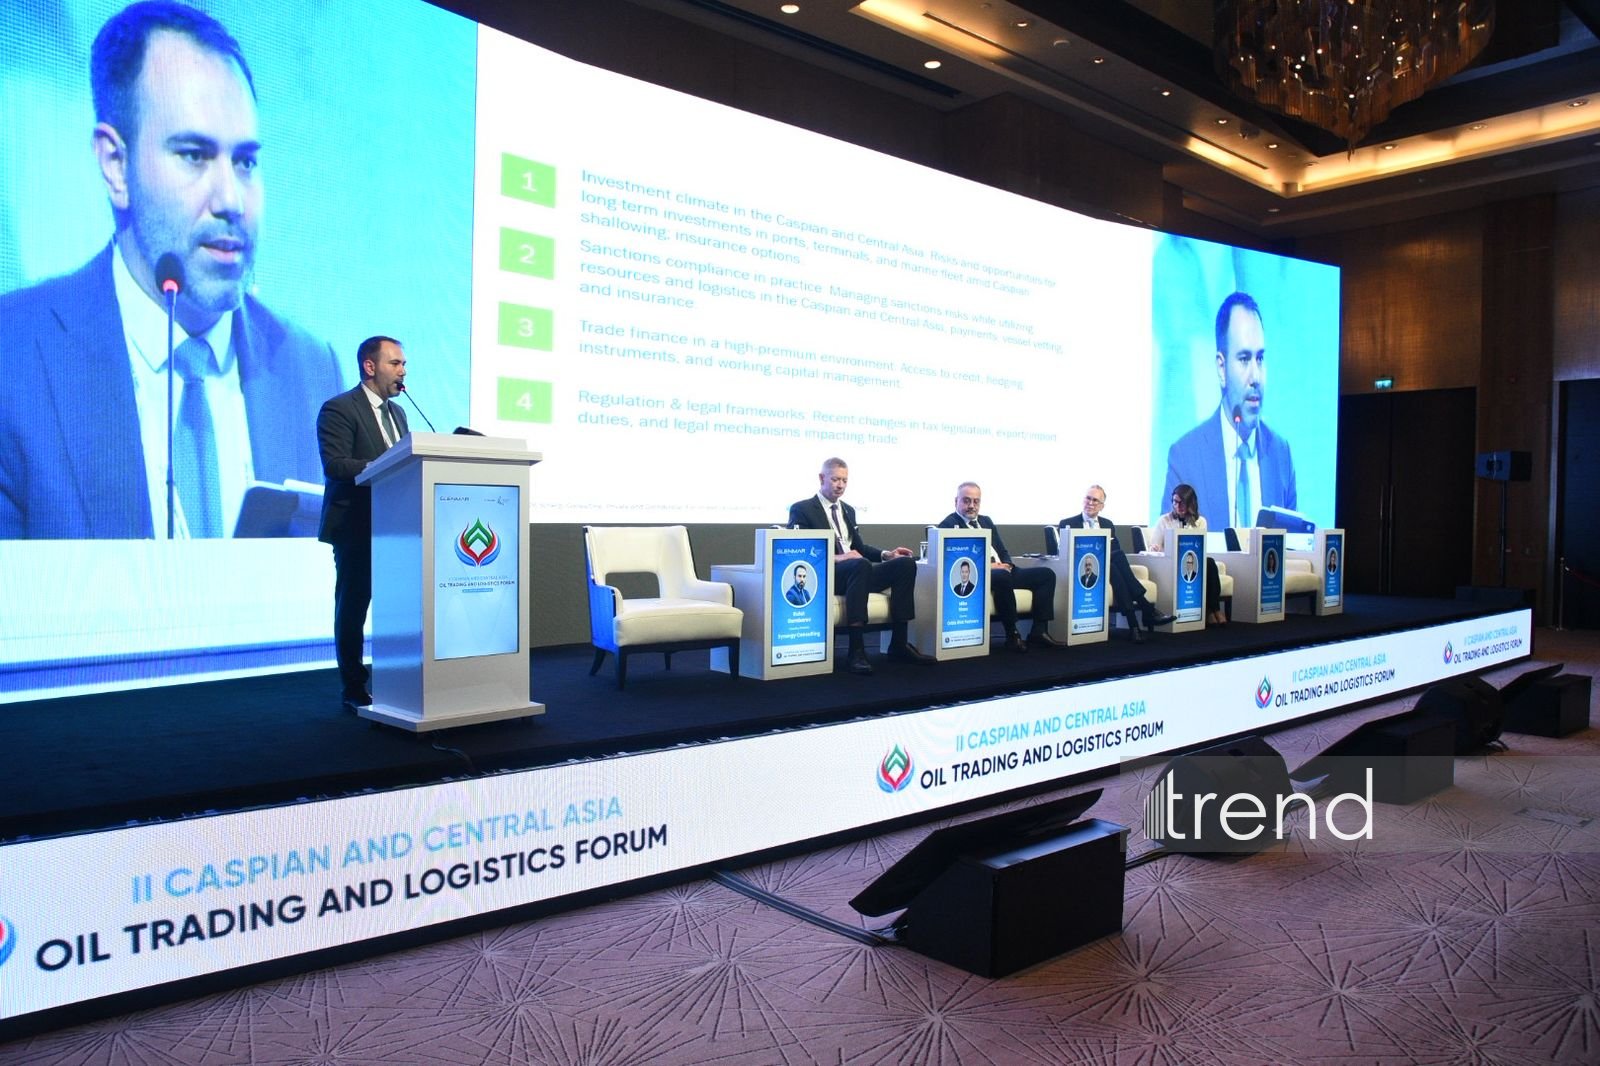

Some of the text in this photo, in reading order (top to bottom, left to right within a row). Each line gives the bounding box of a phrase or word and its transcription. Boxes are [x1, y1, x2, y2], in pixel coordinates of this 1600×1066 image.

[522, 171, 537, 192] 1
[582, 170, 671, 200] Investment
[676, 192, 728, 212] climate
[734, 203, 746, 216] in
[751, 207, 772, 223] the
[776, 213, 828, 235] Caspian
[832, 228, 854, 241] and
[858, 231, 900, 251] Central
[930, 248, 958, 265] Risks
[960, 258, 980, 270] and
[582, 190, 617, 212] long
[622, 198, 658, 217] term
[664, 207, 751, 236] investments
[756, 226, 768, 240] in
[876, 256, 898, 268] and
[901, 261, 938, 277] marine
[940, 268, 964, 281] fleet
[519, 244, 535, 264] 2
[676, 229, 747, 254] insurance
[580, 240, 661, 265] Sanctions
[666, 258, 750, 281] compliance
[754, 271, 766, 284] in
[830, 285, 888, 307] Managing
[891, 299, 942, 317] sanctions
[945, 308, 968, 321] risks
[972, 314, 996, 326] while
[580, 282, 611, 296] and
[580, 264, 660, 285] resources
[665, 278, 693, 290] and
[699, 280, 756, 300] logistics
[761, 290, 772, 303] in
[776, 293, 798, 308] the
[801, 298, 850, 316] Caspian
[854, 309, 876, 320] and
[880, 311, 919, 328] Central
[517, 318, 534, 337] 3
[579, 320, 624, 337] Trade
[630, 326, 688, 345] finance
[692, 335, 706, 347] in
[710, 340, 720, 349] a
[724, 339, 816, 360] high-premium
[901, 362, 937, 376] Access
[684, 356, 712, 367] and
[718, 360, 772, 377] working
[776, 367, 818, 379] capital
[516, 392, 533, 412] 4
[578, 390, 664, 409] Regulation
[670, 398, 682, 410] &
[687, 400, 721, 415] legal
[812, 411, 855, 424] Recent
[858, 416, 906, 430] changes
[910, 420, 920, 430] in
[922, 421, 938, 431] tax
[578, 412, 632, 428] duties,
[639, 417, 668, 429] and
[674, 418, 709, 434] legal
[714, 424, 800, 438] mechanisms
[805, 429, 864, 445] impacting
[1298, 666, 1328, 682] CASPIAN
[1330, 662, 1344, 674] AND
[1345, 656, 1372, 672] CENTRAL
[1373, 652, 1386, 665] ASIA
[1275, 668, 1396, 708] OIL TRADING AND LOGISTICS FORUM
[956, 700, 1146, 752] II CASPIAN AND CENTRAL ASIA
[920, 720, 1164, 790] OIL TRADING AND LOGISTICS FORUM
[132, 796, 624, 904] II CASPIAN AND CENTRAL ASIA
[35, 824, 668, 972] OIL TRADING AND LOGISTICS FORUM
